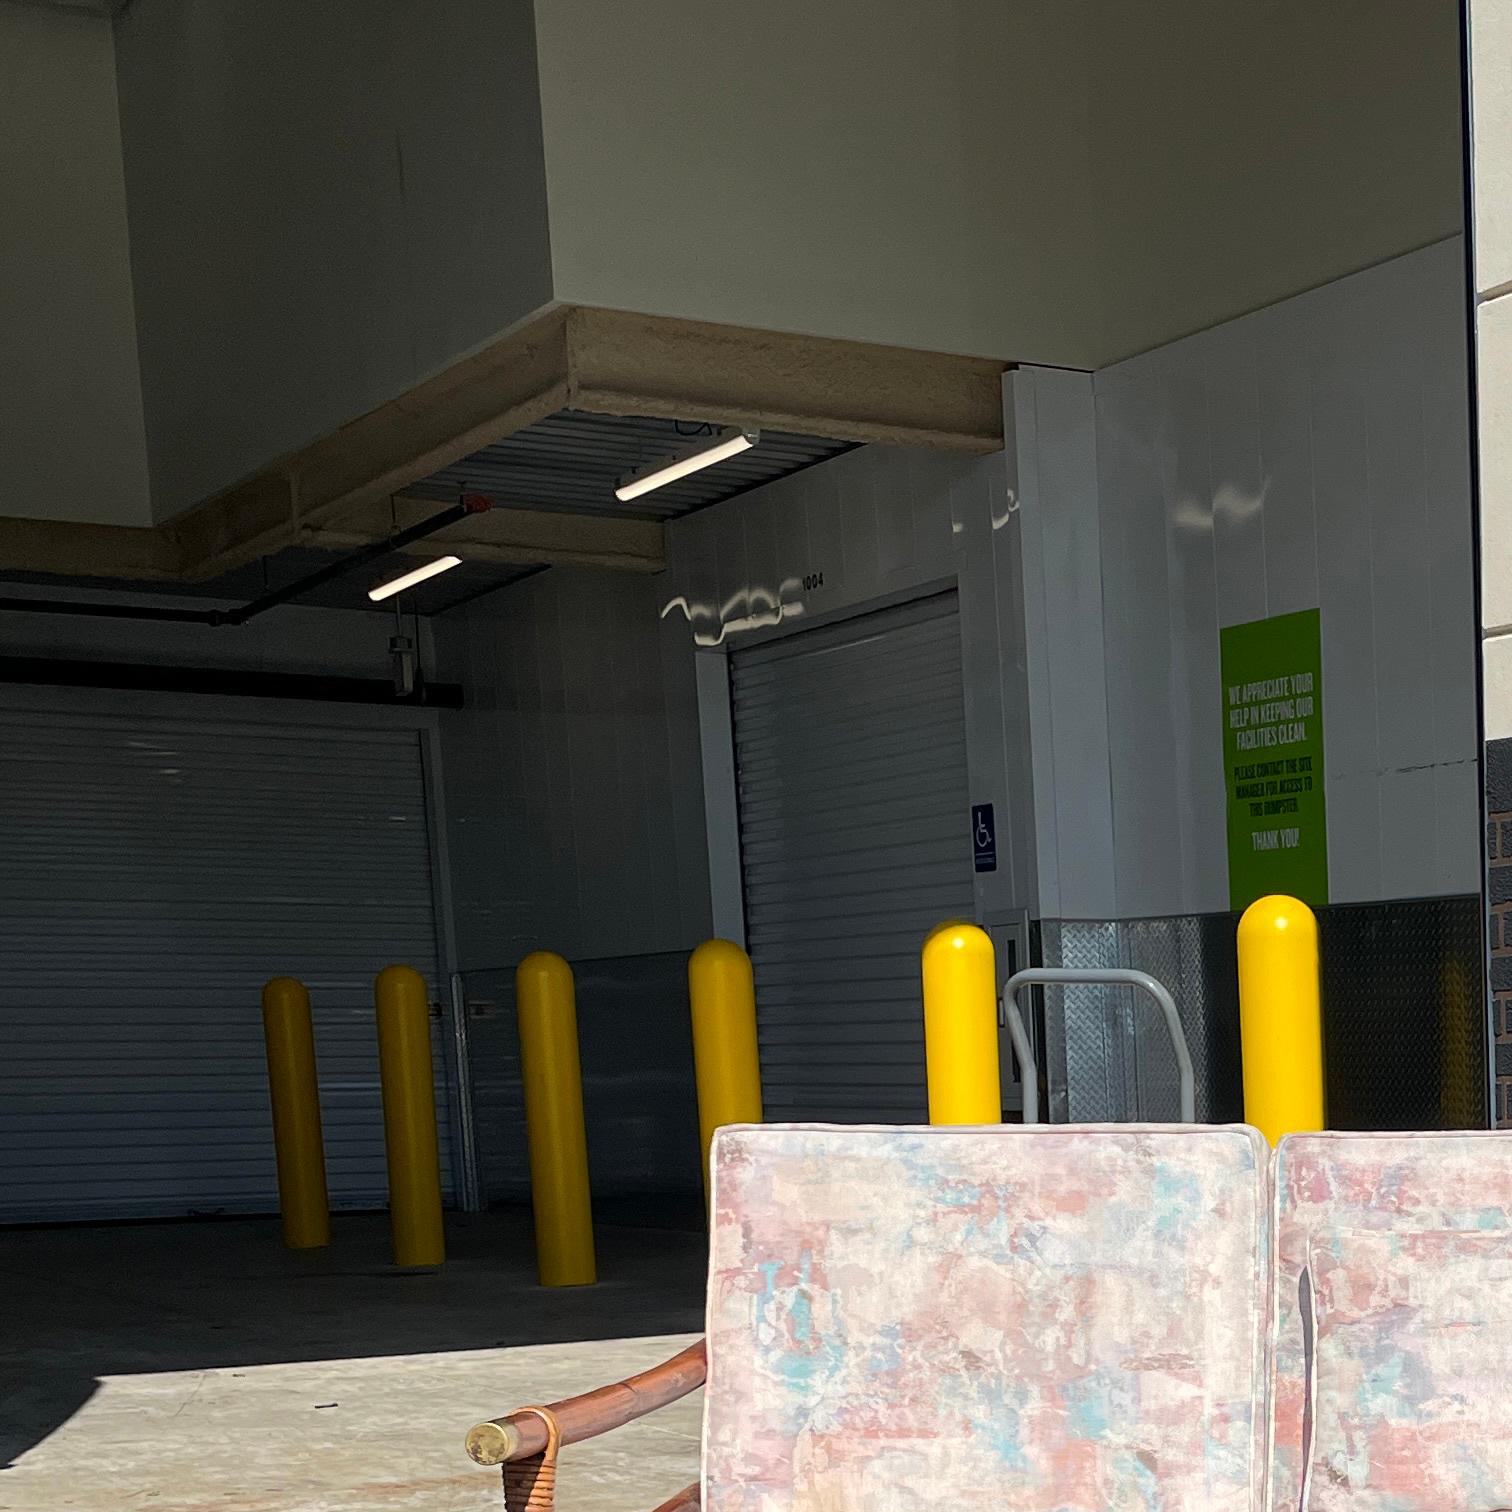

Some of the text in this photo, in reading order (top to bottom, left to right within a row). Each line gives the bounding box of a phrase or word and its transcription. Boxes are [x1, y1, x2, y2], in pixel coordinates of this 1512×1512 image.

[802, 572, 824, 591] 1004
[1228, 672, 1313, 705] WE APPRECIATE YOUR
[1230, 696, 1313, 729] HELP IN KEEPING OUR
[1236, 722, 1307, 750] FACILITIES CLEAN.
[1234, 757, 1312, 781] PLEASE CONTACT THE SITE
[1235, 776, 1312, 799] MANAGER FOR ACCESS TO
[1249, 802, 1263, 816] THIS
[1252, 828, 1300, 851] THANK YOU!
